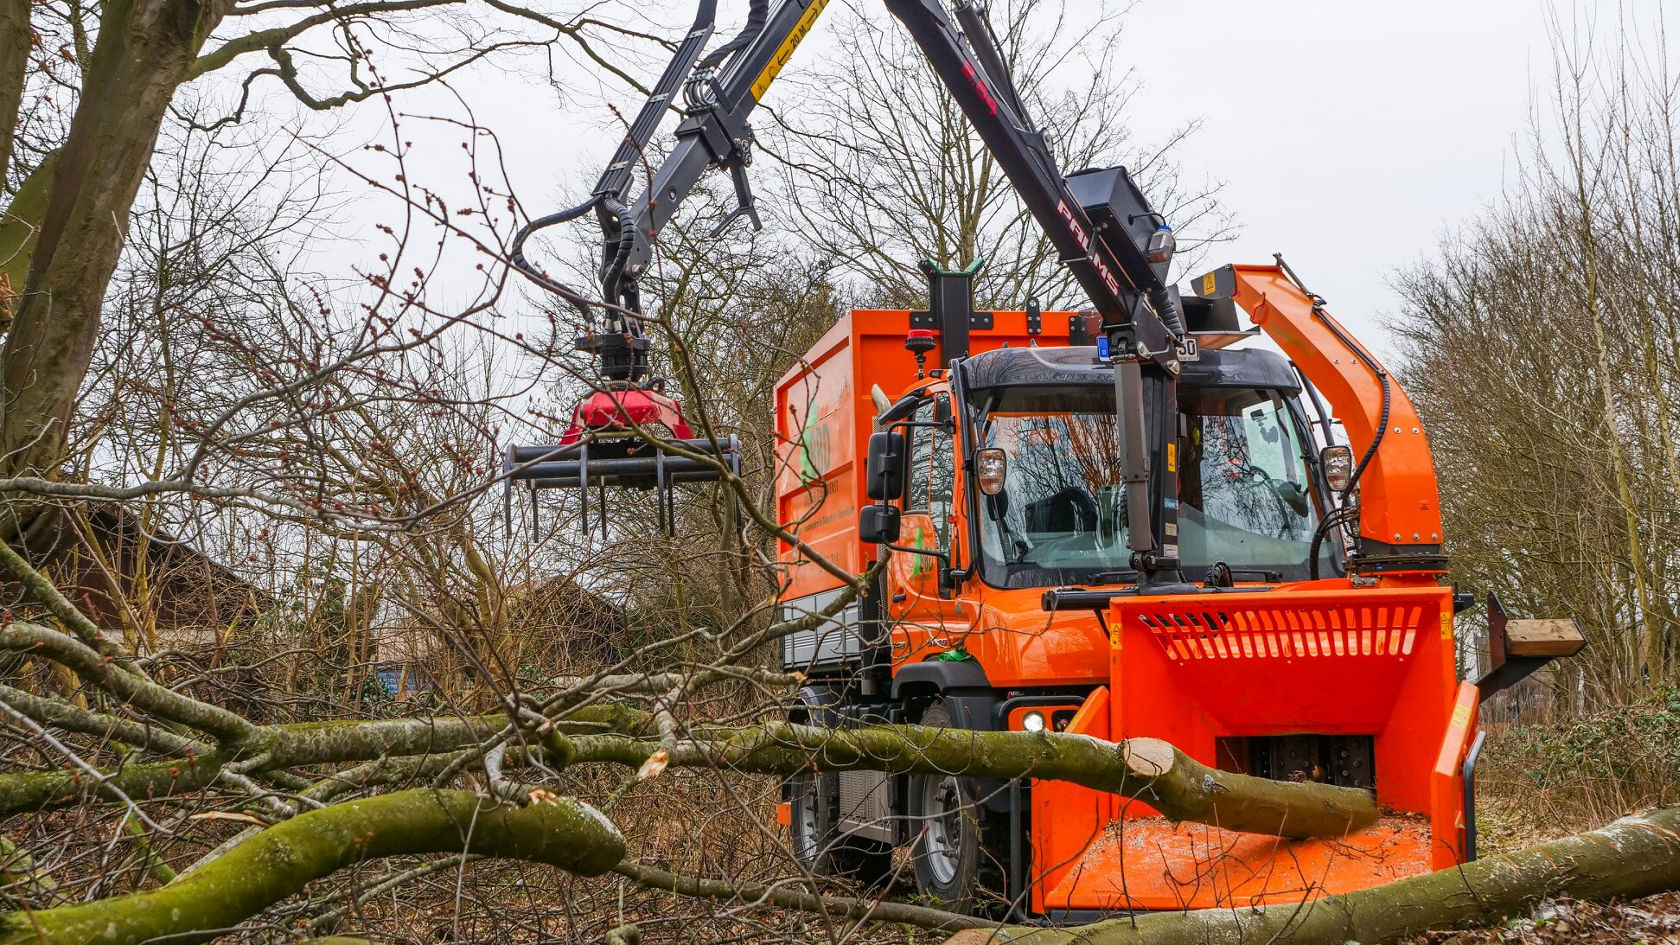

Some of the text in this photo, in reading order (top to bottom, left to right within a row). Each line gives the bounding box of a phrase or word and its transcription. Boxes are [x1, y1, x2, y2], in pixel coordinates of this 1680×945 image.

[790, 25, 807, 48] 20 M
[1056, 198, 1120, 297] PALMS
